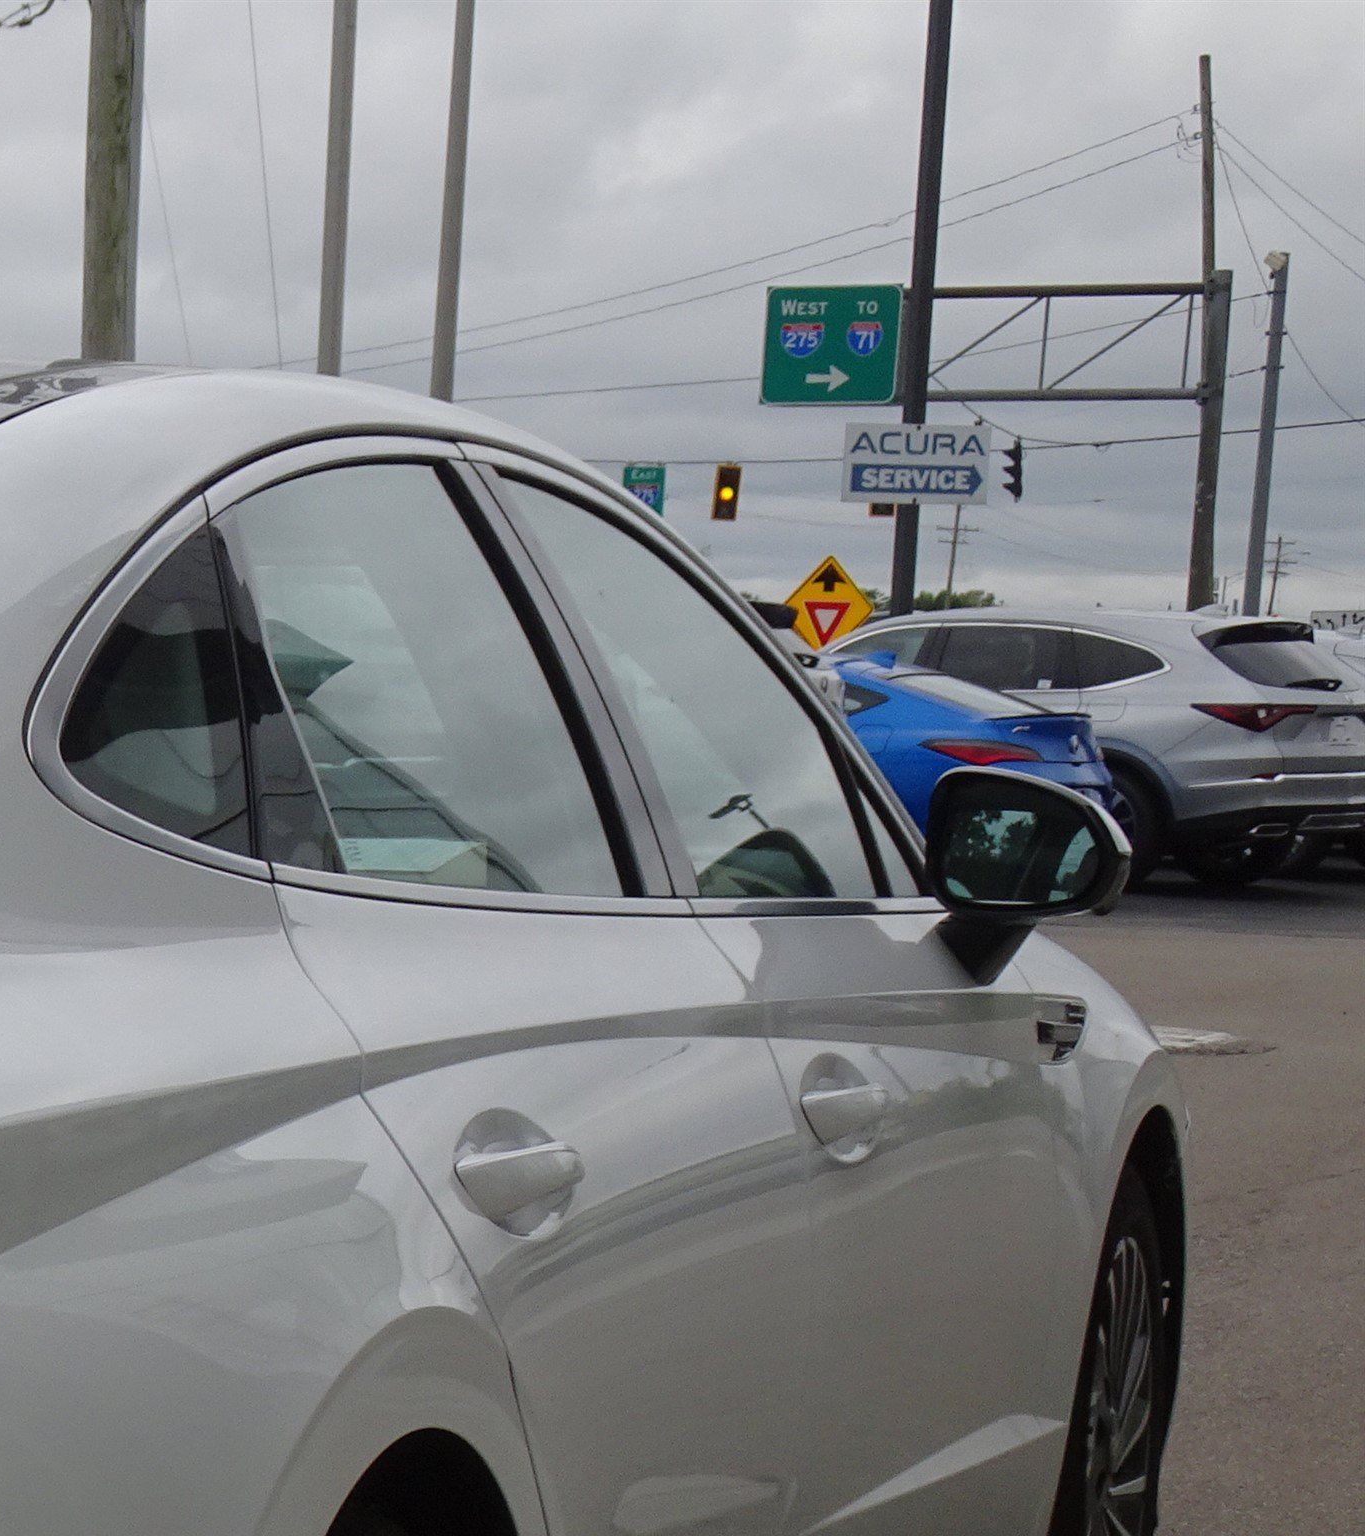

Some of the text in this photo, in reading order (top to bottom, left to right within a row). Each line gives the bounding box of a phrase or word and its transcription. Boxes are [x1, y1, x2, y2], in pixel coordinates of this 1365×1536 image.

[780, 299, 879, 317] WEST TO
[784, 331, 876, 350] 275 71
[850, 431, 987, 457] ACURA
[860, 467, 971, 492] SERVICE
